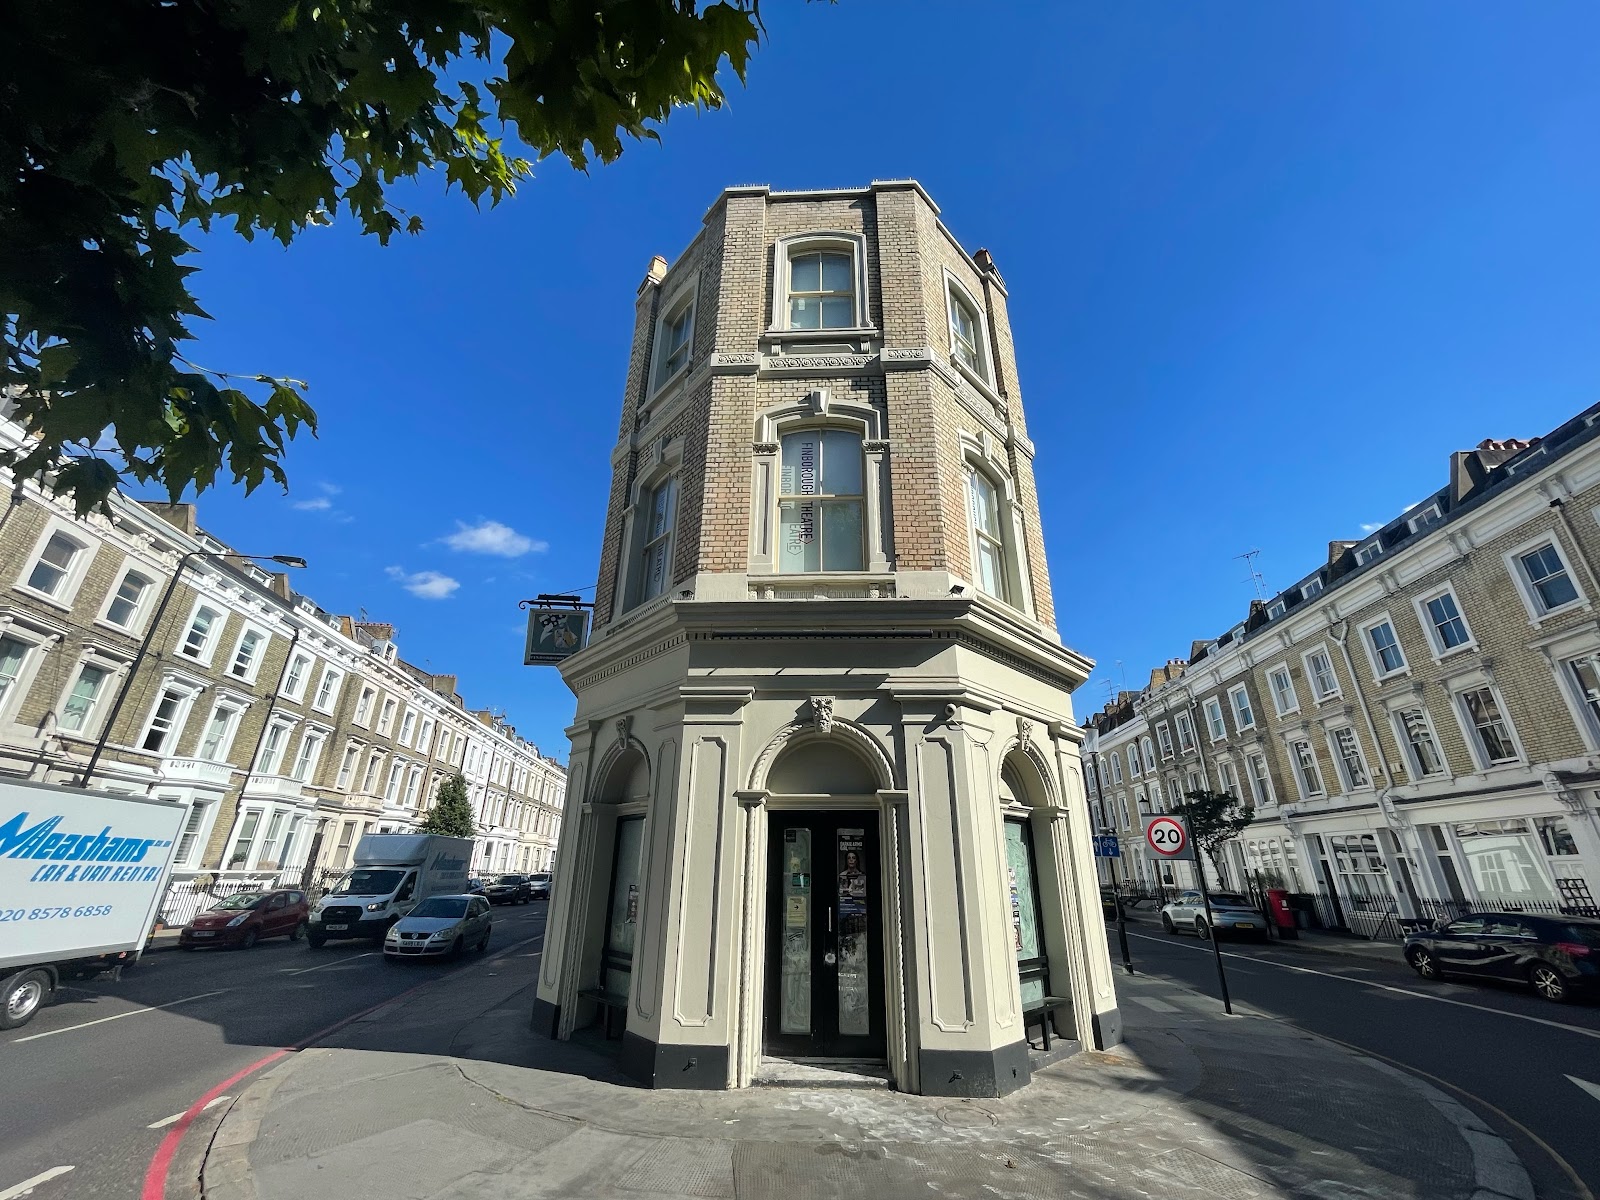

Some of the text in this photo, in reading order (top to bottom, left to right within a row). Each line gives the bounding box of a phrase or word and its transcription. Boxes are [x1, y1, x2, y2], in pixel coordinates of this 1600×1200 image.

[800, 442, 814, 539] FINBOROUGH THEATRE
[1154, 828, 1181, 844] 20
[30, 864, 163, 882] CAR & VAN RENTAL
[27, 907, 72, 921] 8578
[74, 905, 113, 918] 6858
